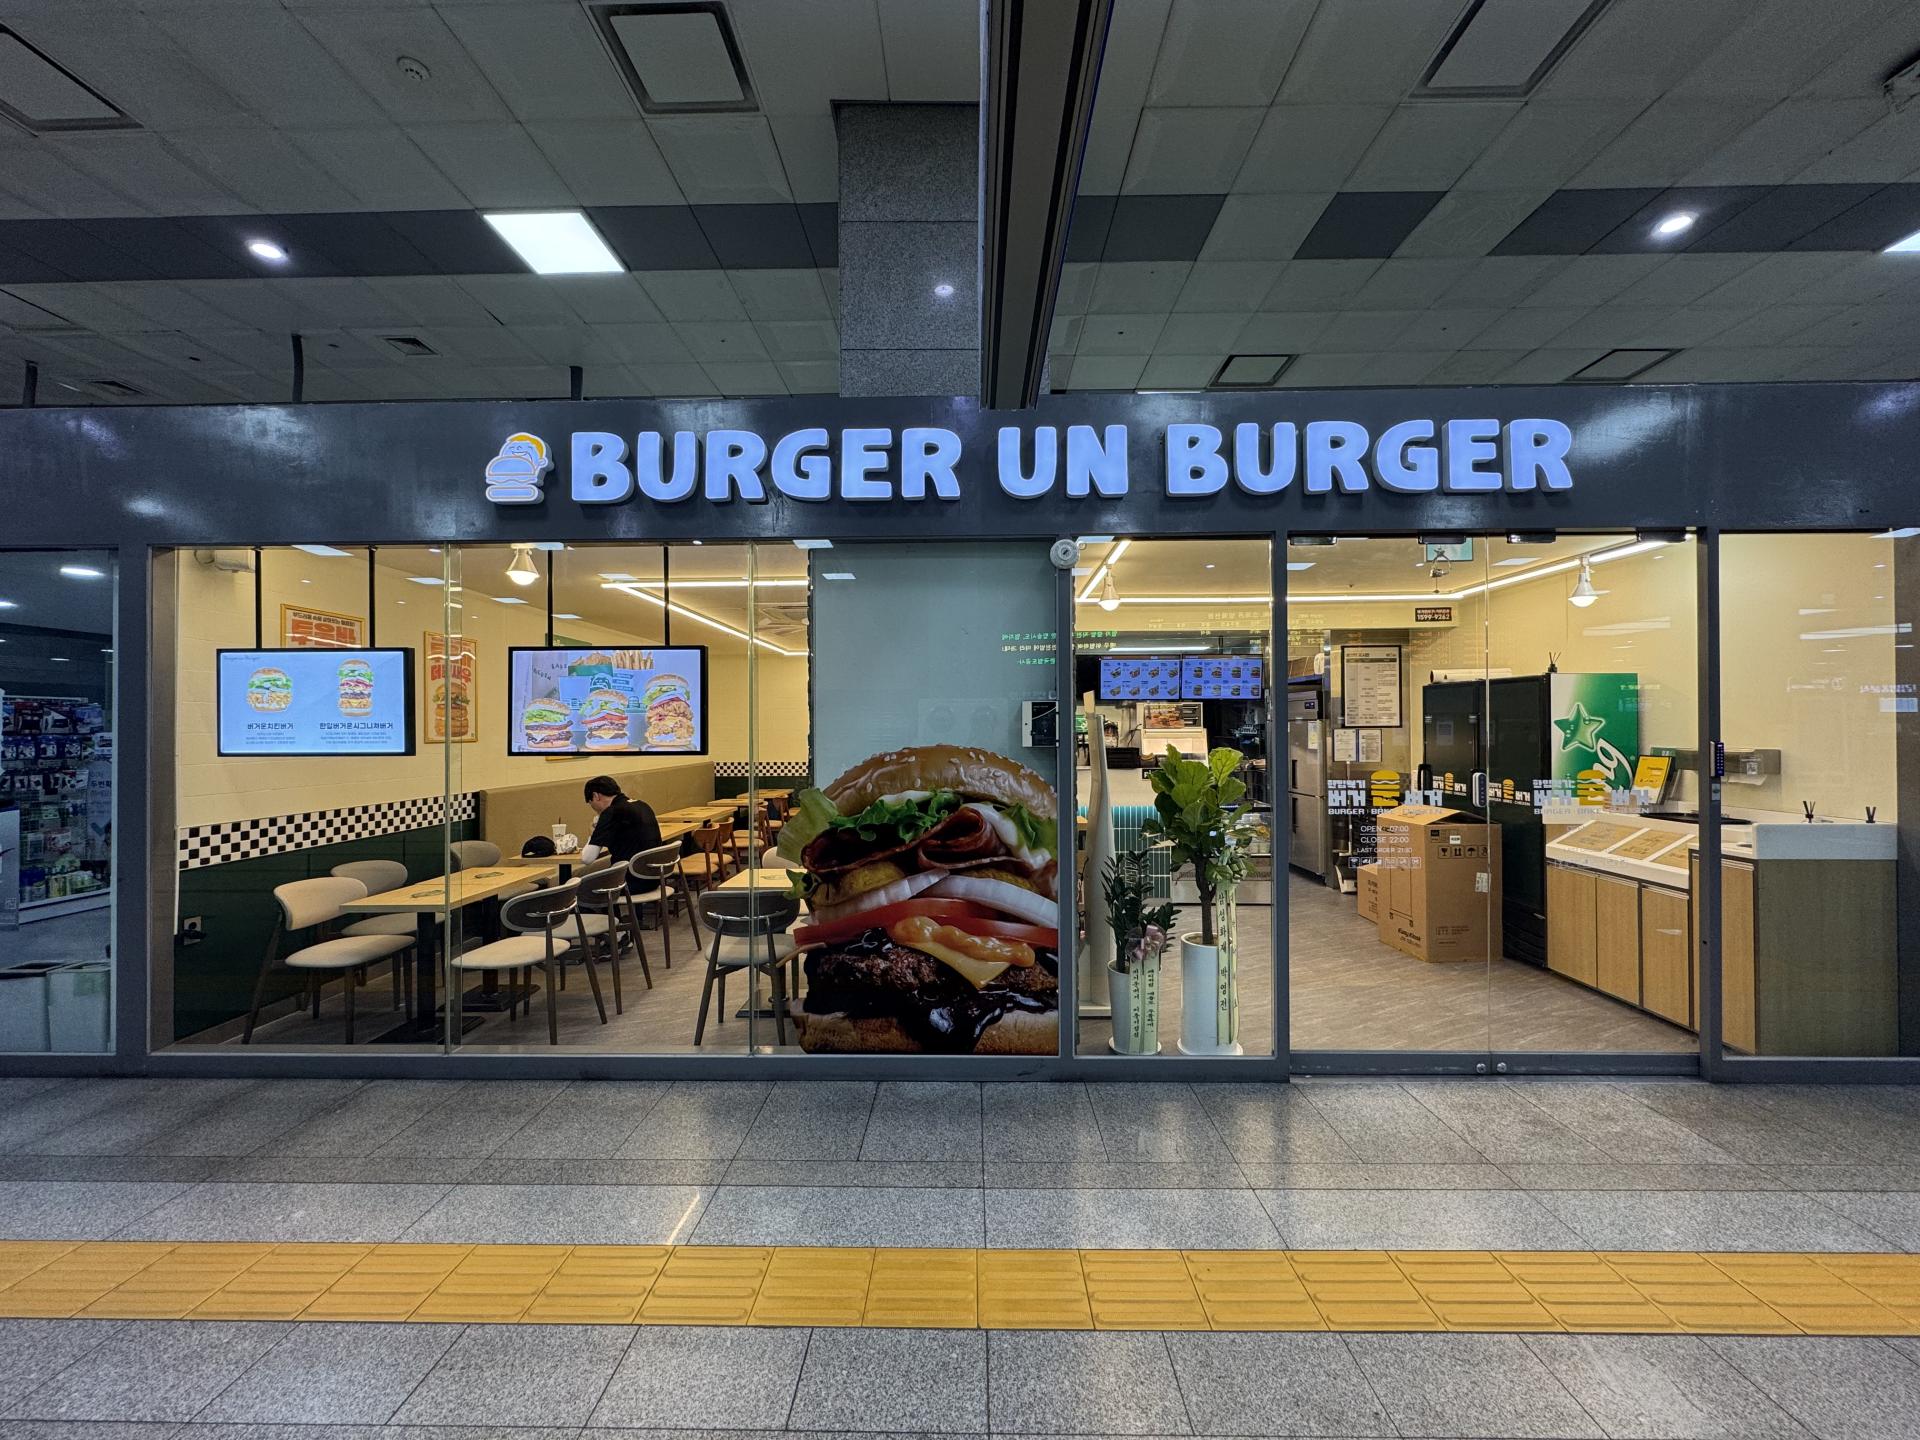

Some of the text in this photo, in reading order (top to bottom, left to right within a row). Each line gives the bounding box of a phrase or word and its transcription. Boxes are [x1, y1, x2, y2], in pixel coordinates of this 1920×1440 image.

[571, 418, 1573, 502] BURGER UN BURGER
